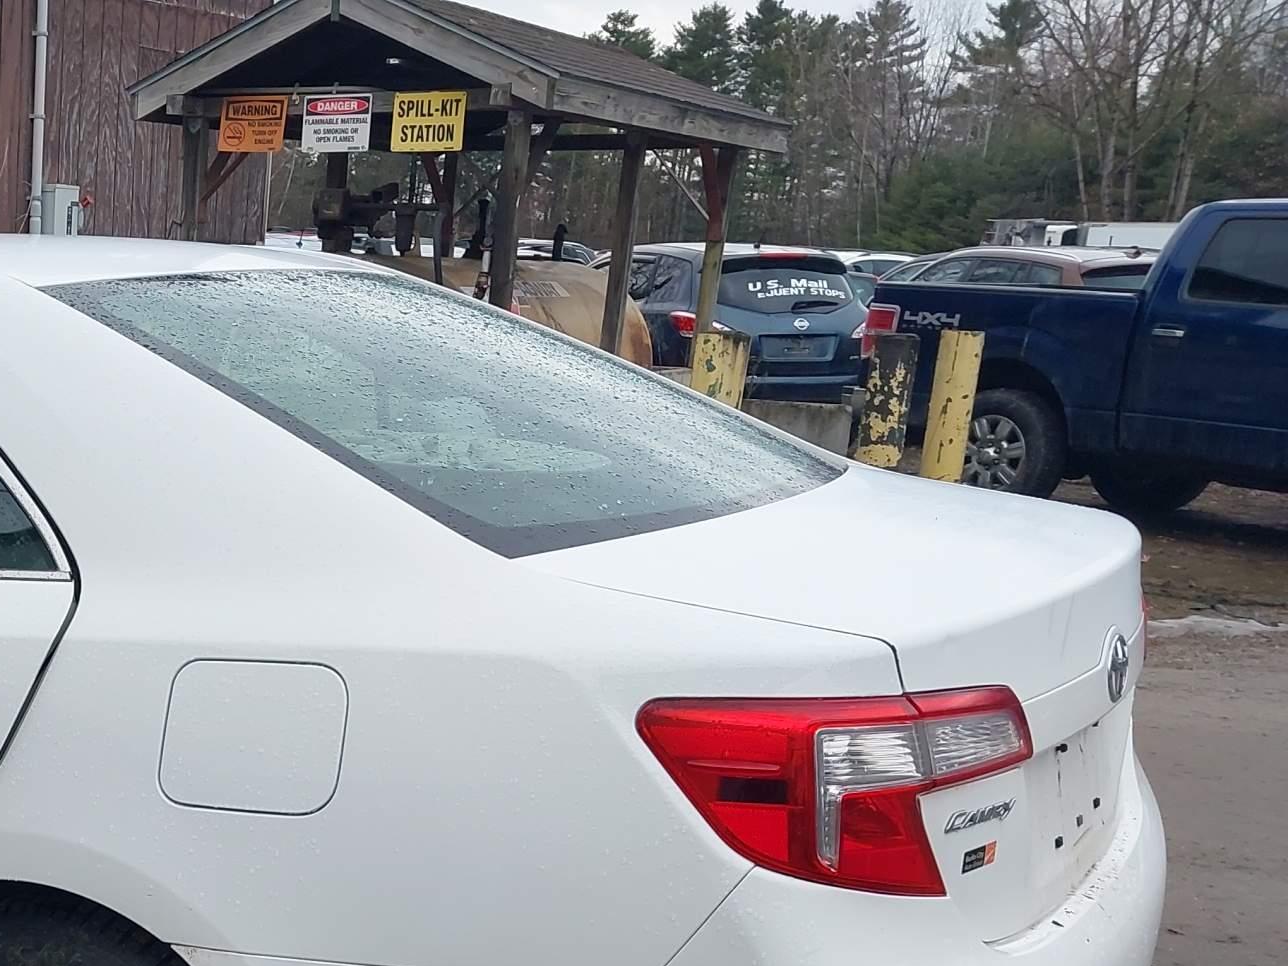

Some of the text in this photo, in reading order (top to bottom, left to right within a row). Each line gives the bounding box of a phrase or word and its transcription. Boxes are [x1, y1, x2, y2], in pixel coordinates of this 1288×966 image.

[232, 104, 278, 116] WARNING
[317, 101, 358, 112] DANGER
[397, 98, 462, 118] SPILL-KIT
[340, 117, 368, 125] MATERIAL
[350, 127, 359, 135] OR
[400, 123, 455, 142] STATION
[810, 288, 846, 299] STOPS
